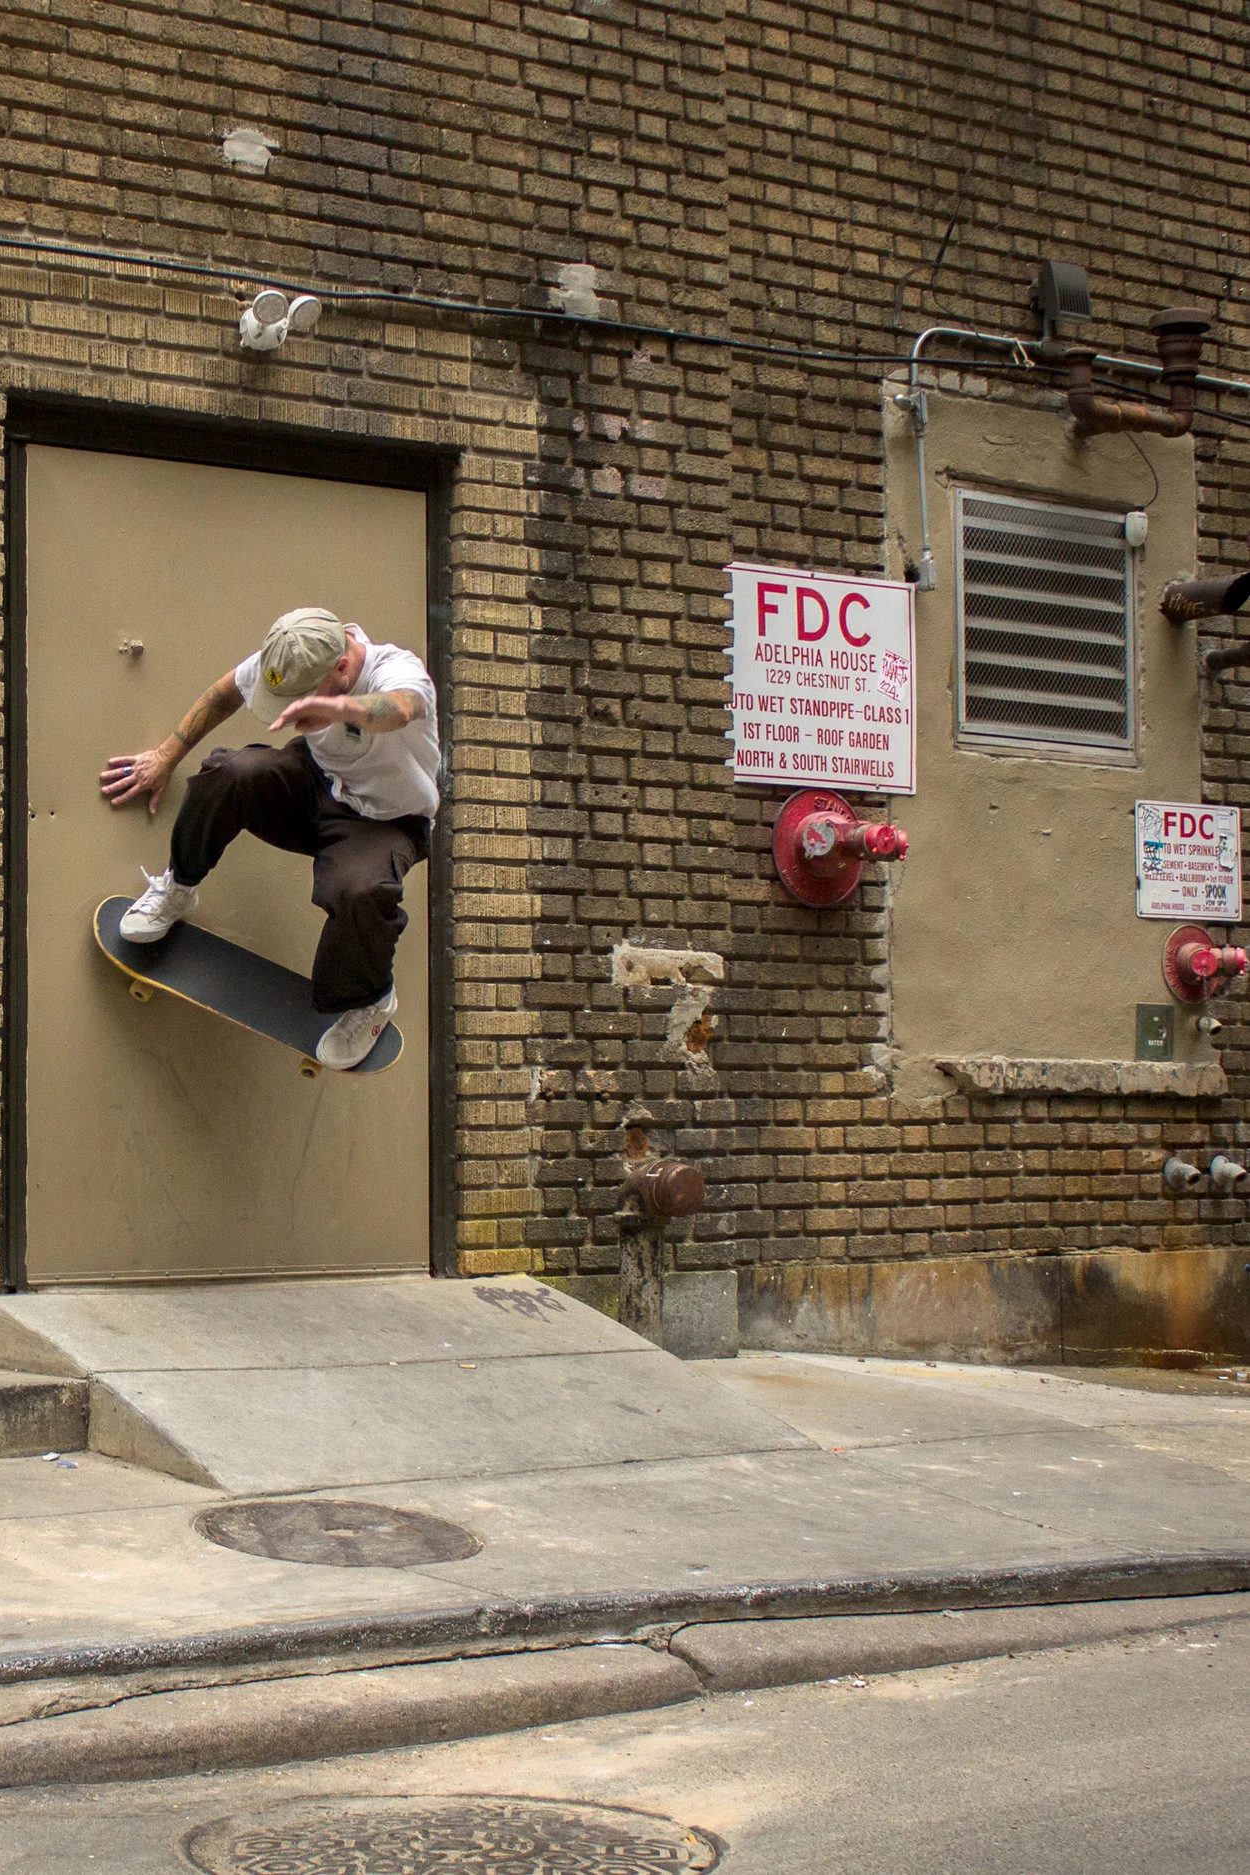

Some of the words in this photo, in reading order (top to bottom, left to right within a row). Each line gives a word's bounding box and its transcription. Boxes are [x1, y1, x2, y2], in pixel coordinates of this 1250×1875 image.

[757, 582, 871, 647] FDC
[755, 643, 823, 668] ADELPHIA
[830, 650, 877, 672] HOUSE
[766, 668, 790, 684] 1229
[796, 672, 850, 690] CHESTNUT
[855, 677, 871, 693] ST.
[758, 695, 784, 713] WET
[743, 722, 761, 740] 1ST
[766, 724, 799, 743] FLOOR
[817, 728, 844, 746] ROOF
[849, 731, 889, 750] GARDEN
[737, 750, 774, 768] NORTH
[779, 753, 787, 769] &
[793, 754, 827, 772] SOUTH
[832, 756, 894, 778] STAIRWELLS
[1164, 812, 1214, 840] FDC
[1173, 844, 1187, 855] WET
[1160, 873, 1174, 881] LEVEL
[1180, 874, 1206, 883] BALLROOM
[1218, 876, 1233, 885] FLOOR
[1188, 862, 1214, 872] BASEMENT
[1182, 886, 1197, 897] ONLY
